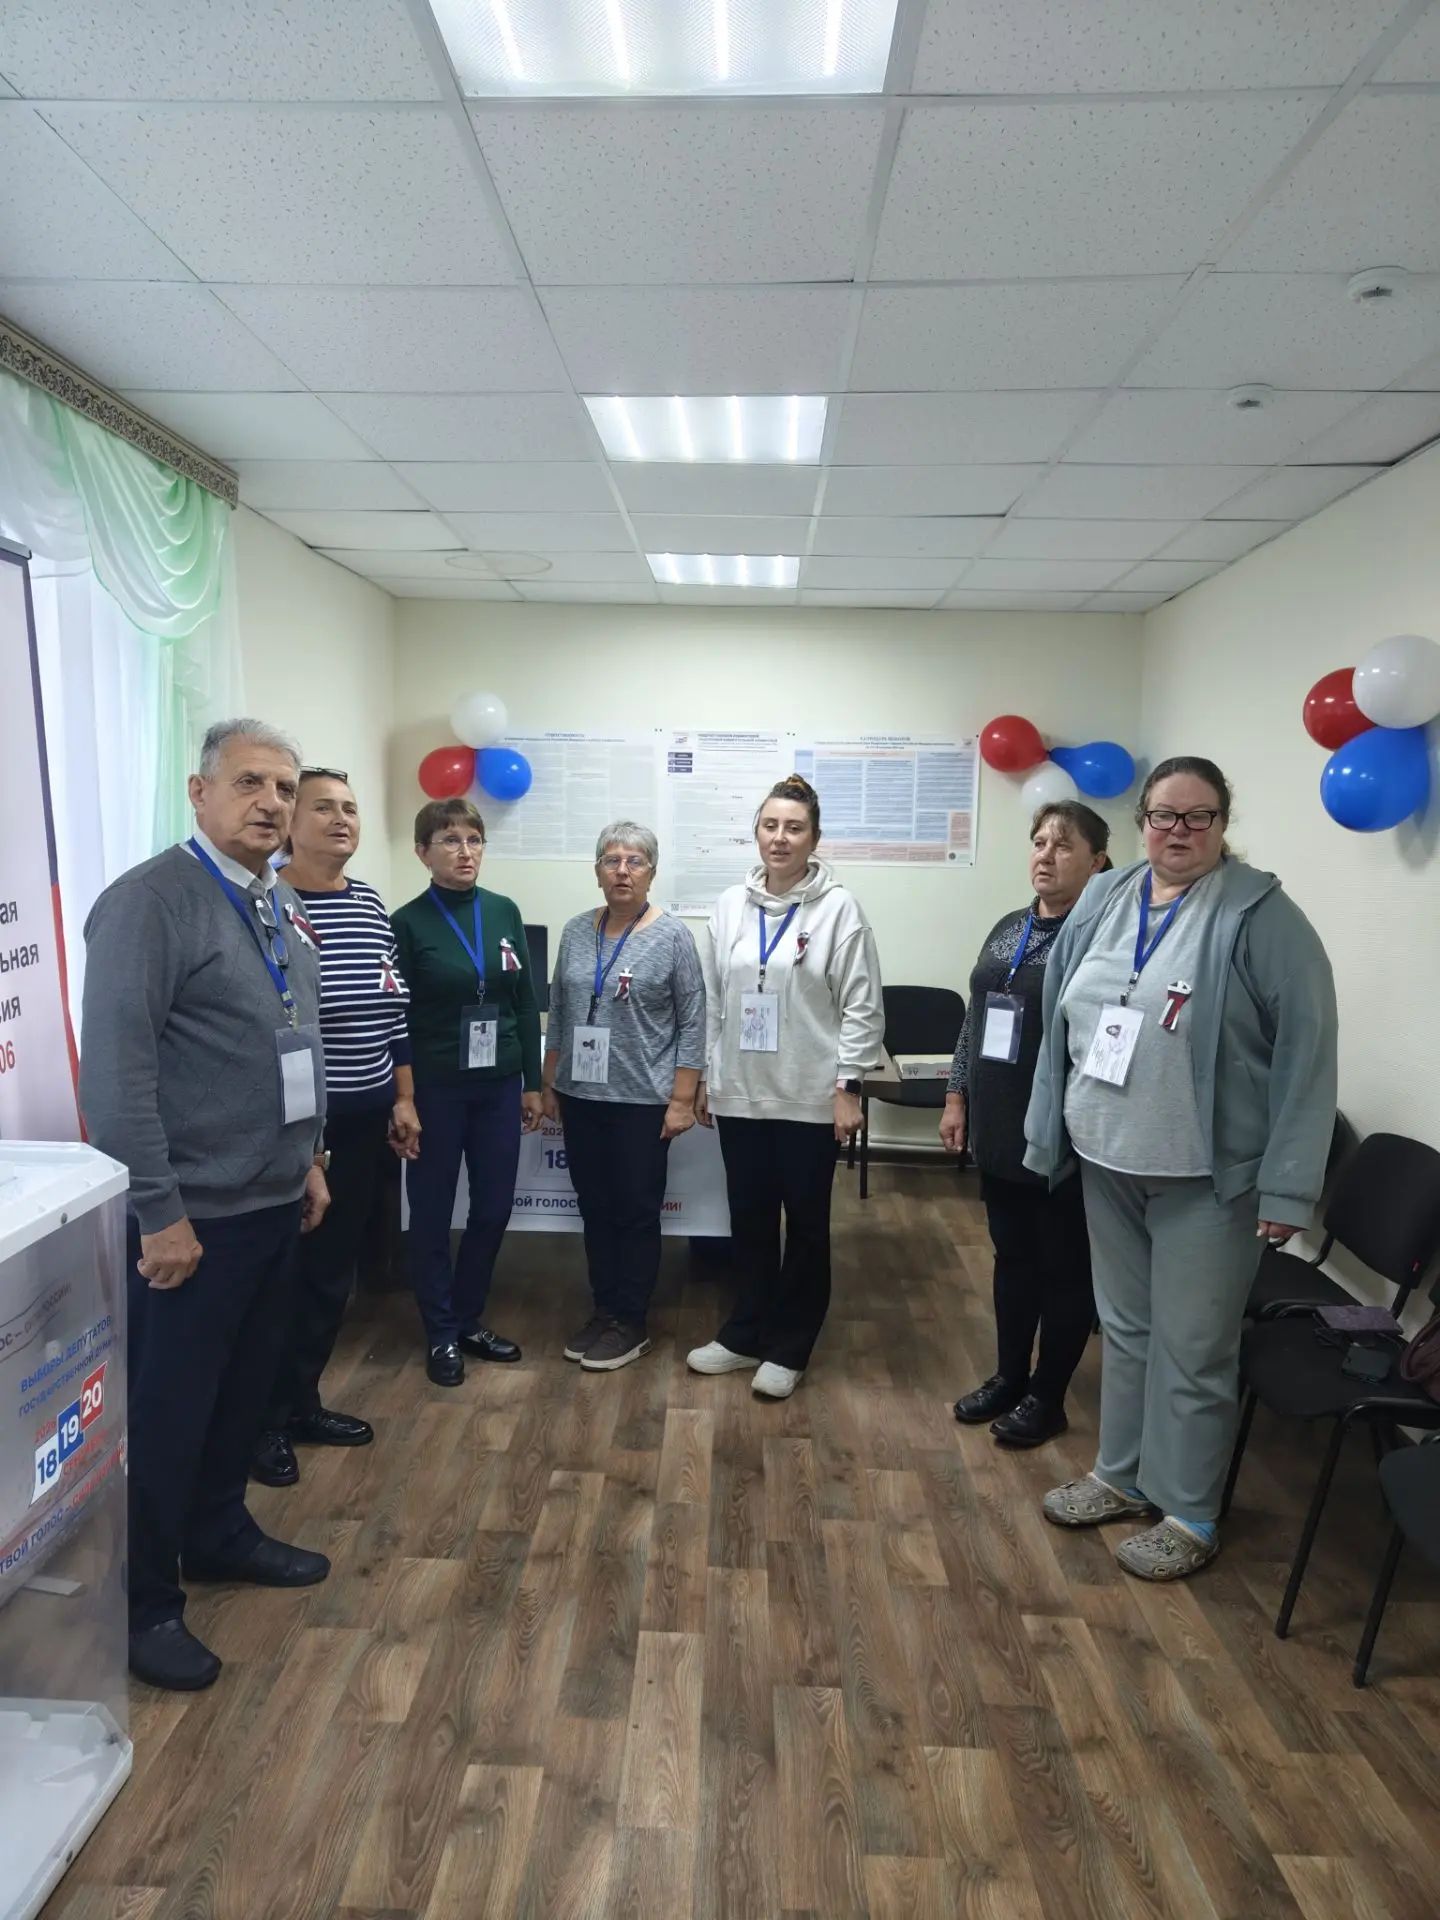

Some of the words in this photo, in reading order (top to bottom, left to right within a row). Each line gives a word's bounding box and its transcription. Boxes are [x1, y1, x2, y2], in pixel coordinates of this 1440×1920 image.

[0, 995, 22, 1024] ия
[545, 1149, 569, 1170] 18
[535, 1198, 577, 1209] ГОЛОС
[20, 1352, 64, 1393] ВЫБОРЫ
[65, 1315, 112, 1361] ДЕПУТАТОВ
[82, 1380, 102, 1419] 20
[61, 1414, 79, 1450] 19
[37, 1448, 58, 1485] 18
[31, 1507, 63, 1547] ГОЛОС
